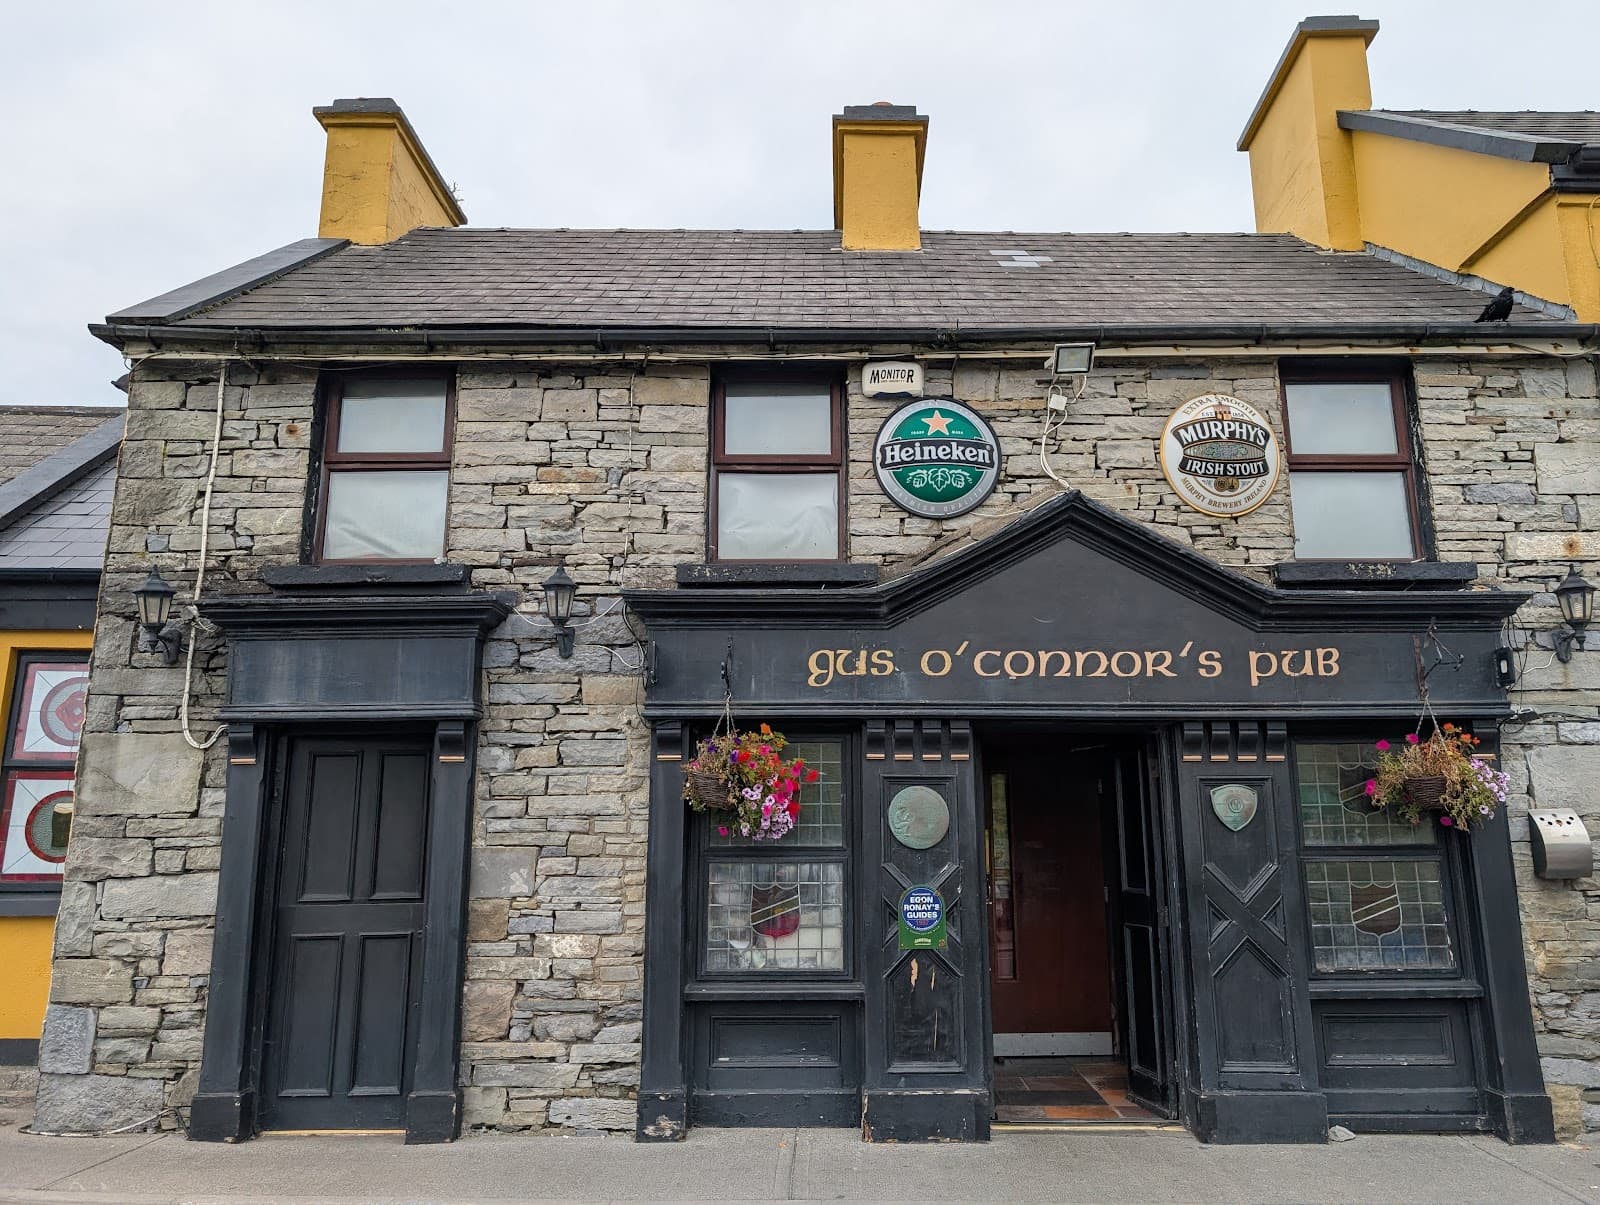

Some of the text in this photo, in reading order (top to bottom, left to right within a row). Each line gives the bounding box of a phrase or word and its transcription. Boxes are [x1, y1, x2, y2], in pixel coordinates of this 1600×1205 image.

[869, 369, 914, 384] MONITOR
[1183, 395, 1257, 417] EXTRA SMOOTH
[1178, 421, 1266, 446] MURPHY'S
[885, 442, 991, 464] Heineken
[1186, 459, 1265, 475] IRISH STOUT
[1182, 477, 1267, 509] MURPHY BREWERY IRELAND
